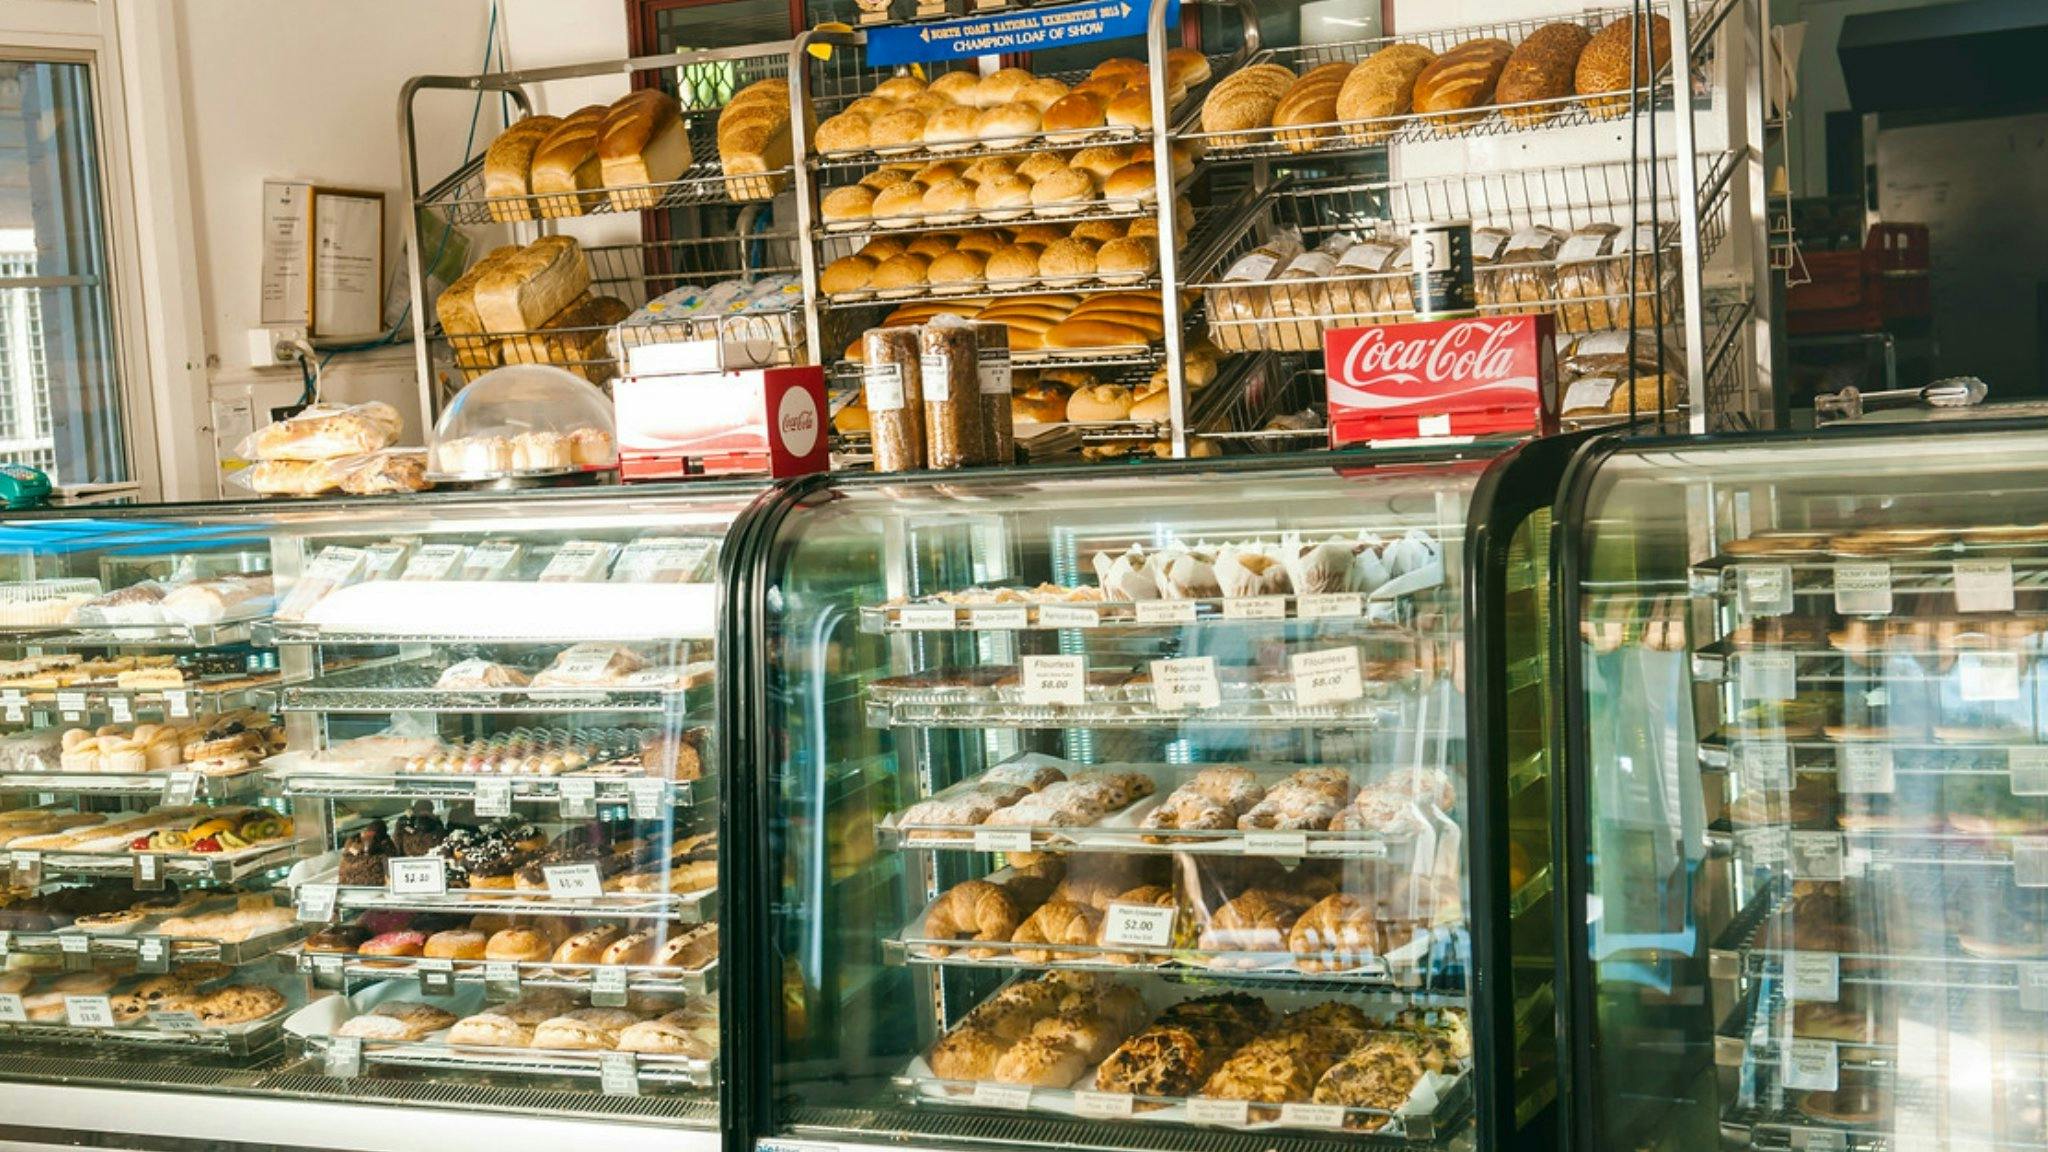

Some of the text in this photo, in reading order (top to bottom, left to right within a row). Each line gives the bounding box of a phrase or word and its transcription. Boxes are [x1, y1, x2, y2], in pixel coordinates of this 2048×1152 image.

[931, 26, 961, 40] NORTH
[963, 24, 991, 37] COAST
[992, 17, 1040, 34] NATIONAL
[1041, 9, 1097, 26] EXHIBITION
[953, 22, 1105, 52] CHAMPION LOAF OF SHOW
[1342, 320, 1525, 387] Coca-Cola
[782, 410, 813, 432] Coca-Cola
[1034, 659, 1074, 669] Flourless
[1123, 919, 1154, 931] $2.00
